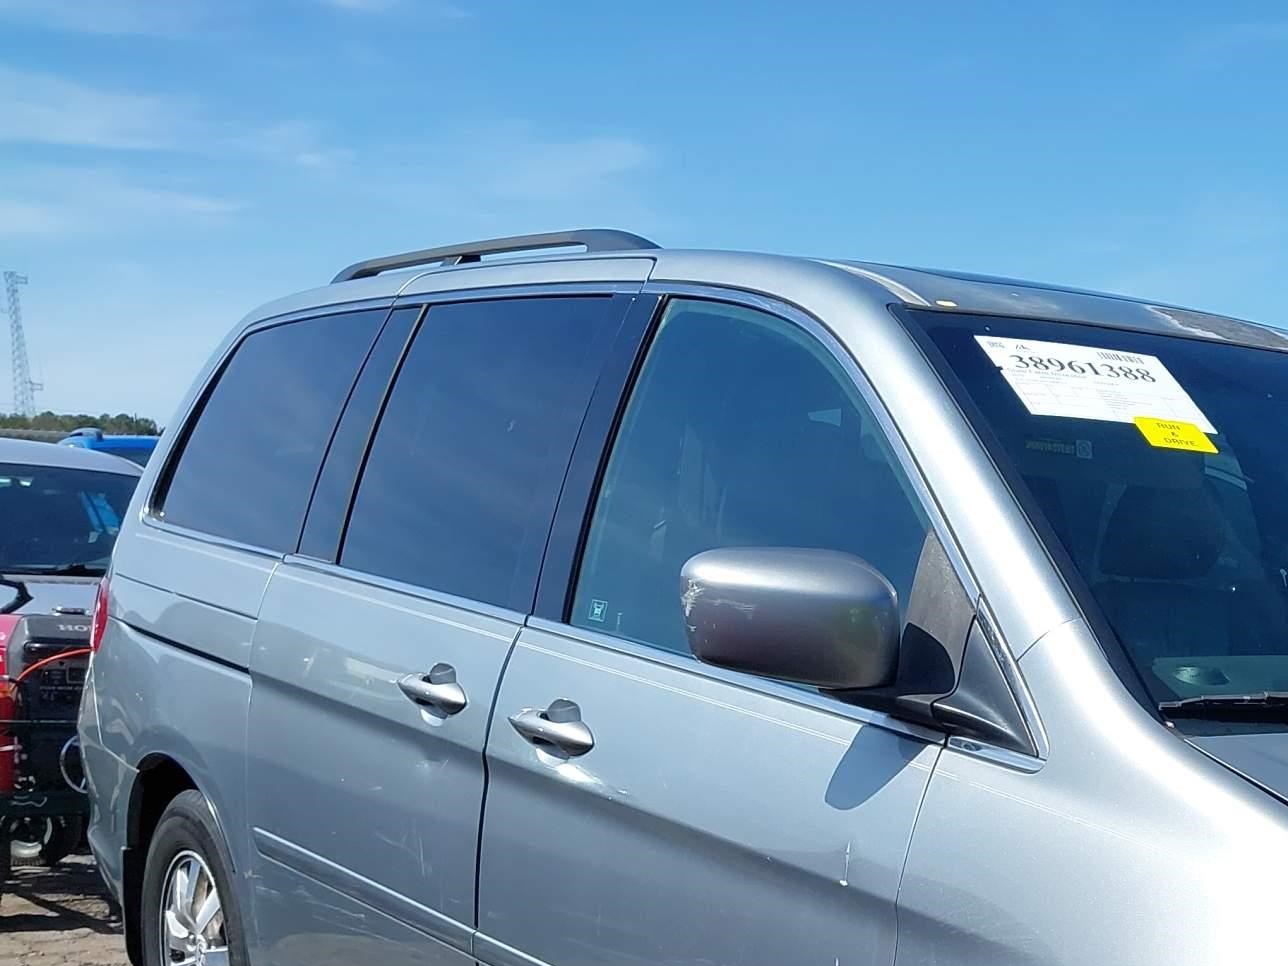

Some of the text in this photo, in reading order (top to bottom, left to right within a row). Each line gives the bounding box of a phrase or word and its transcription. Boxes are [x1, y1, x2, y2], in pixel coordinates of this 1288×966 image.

[1009, 353, 1157, 384] 38961388
[1155, 422, 1182, 431] RUN
[1163, 437, 1197, 447] DRIVE
